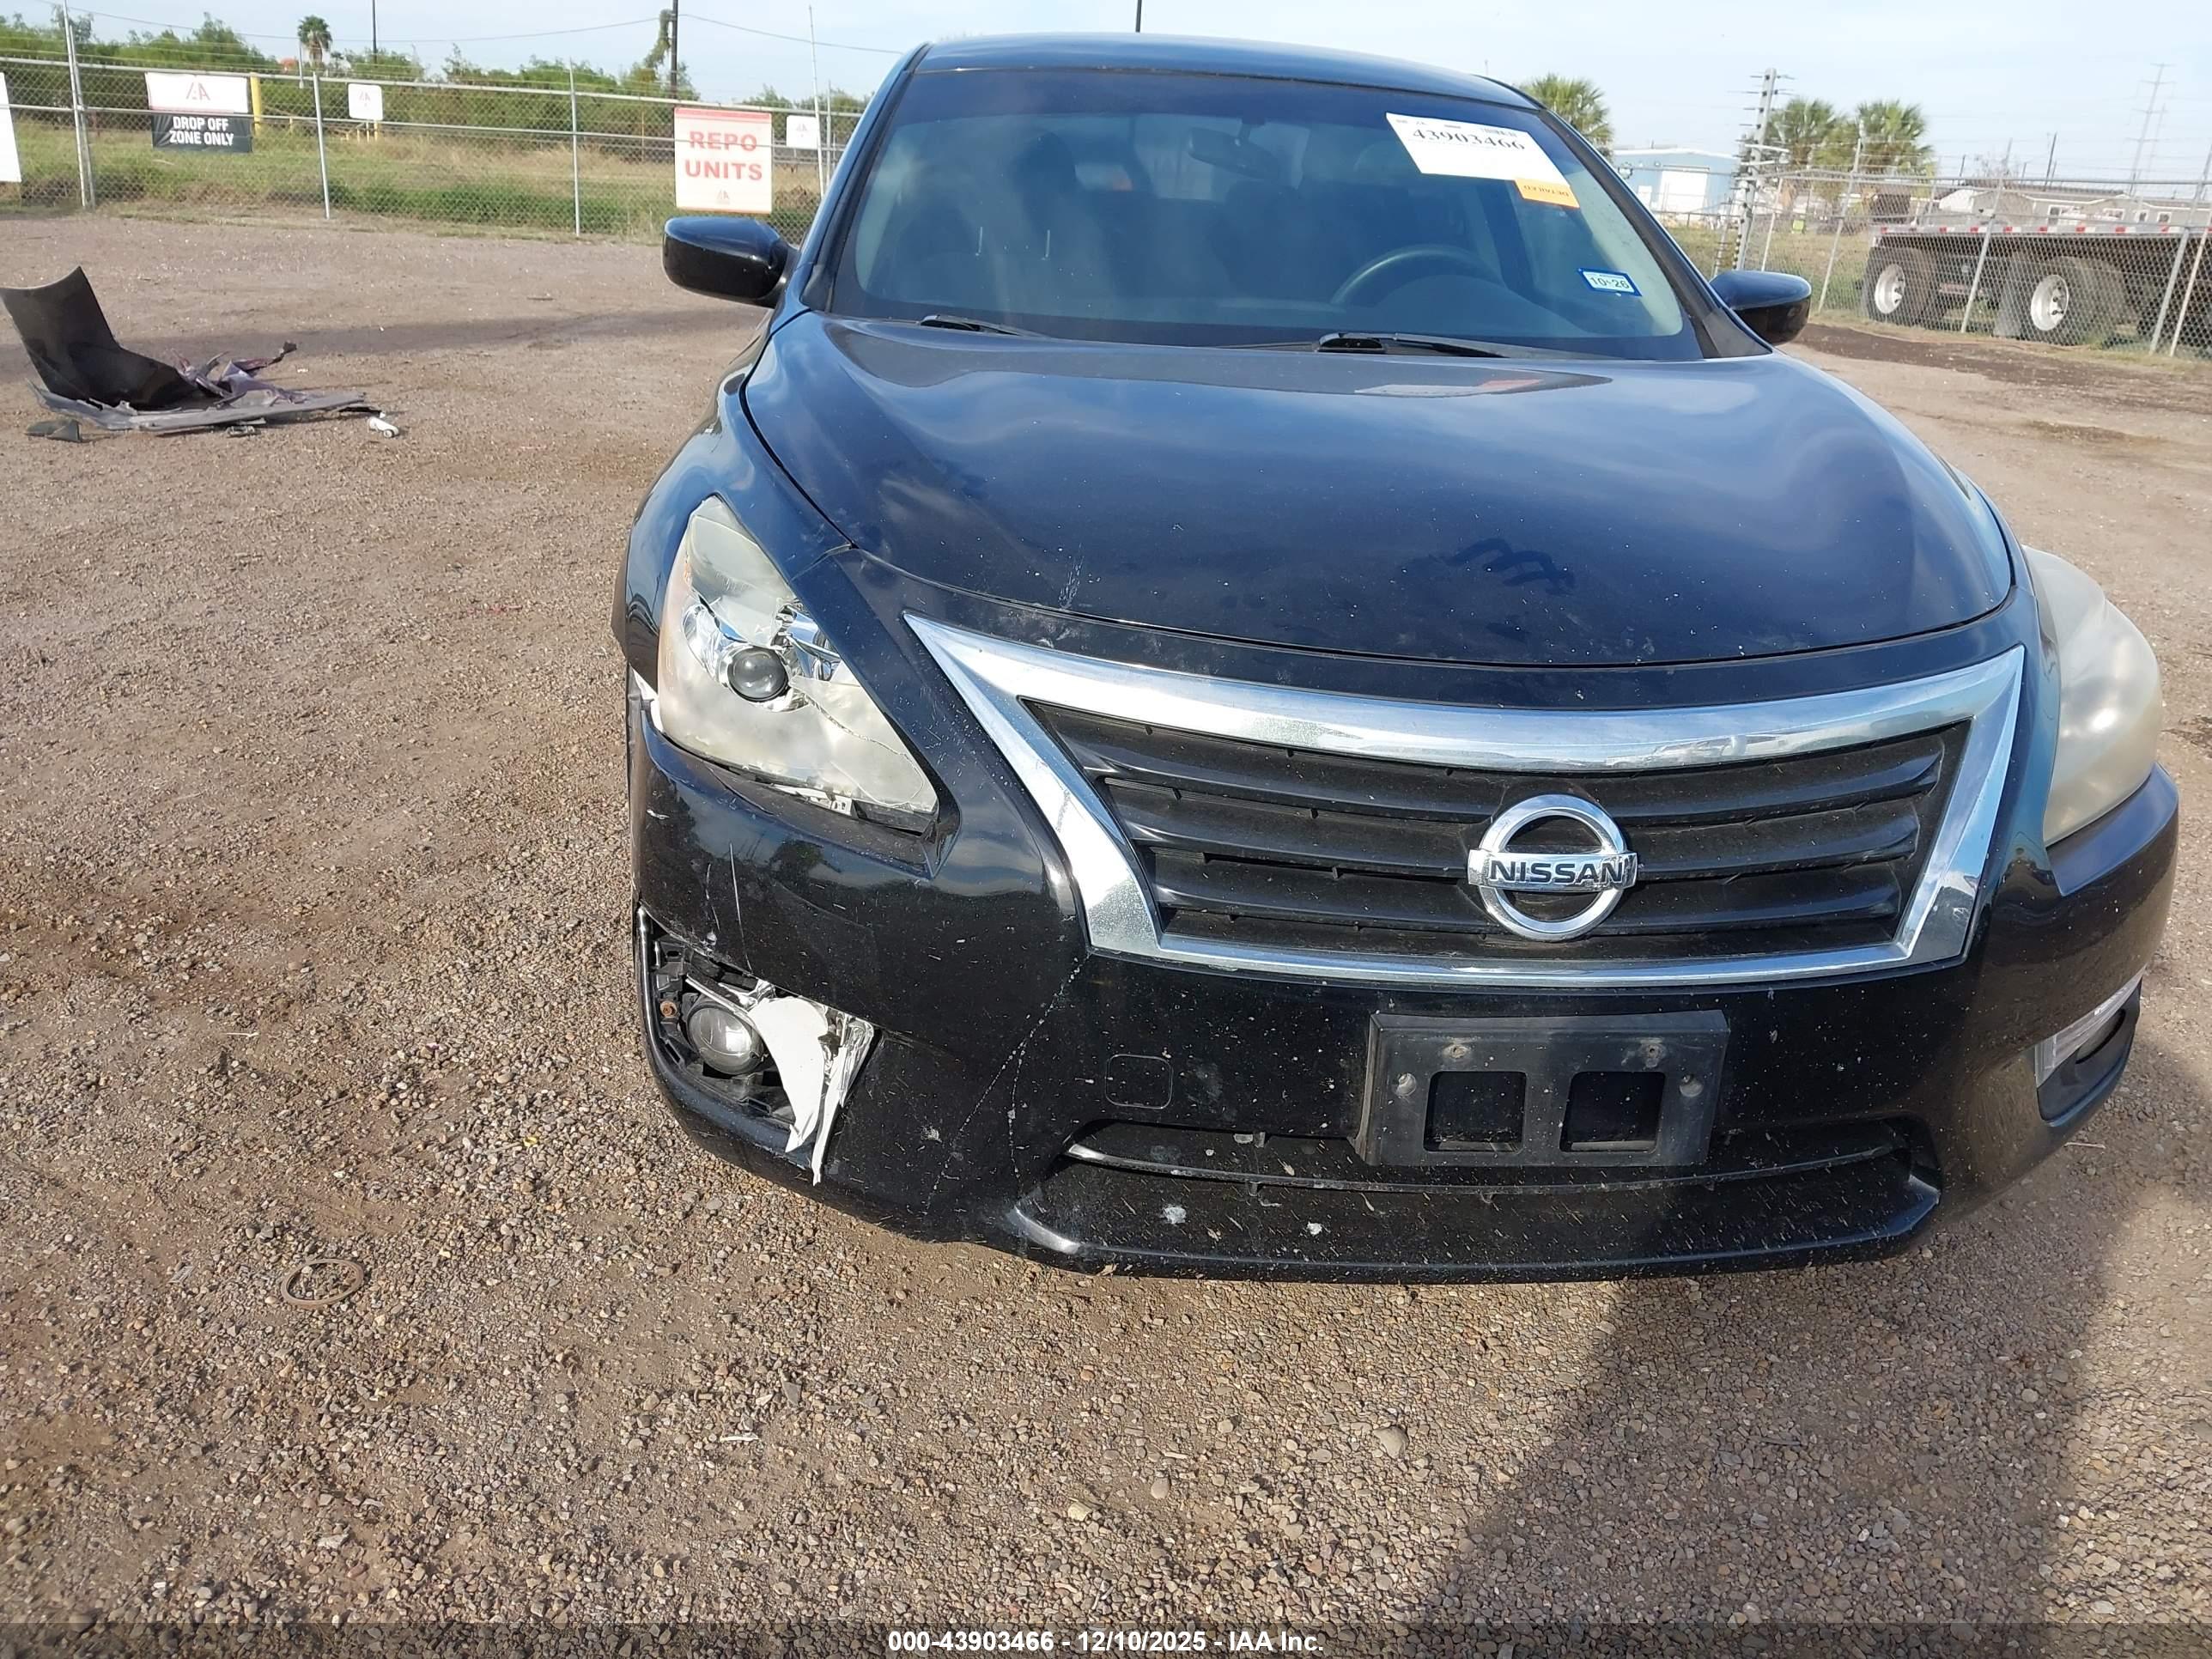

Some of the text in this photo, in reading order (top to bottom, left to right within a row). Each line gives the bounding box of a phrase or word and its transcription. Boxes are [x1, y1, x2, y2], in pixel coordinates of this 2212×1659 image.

[173, 116, 229, 131] DROP OFF
[168, 130, 234, 146] ZONE ONLY
[689, 130, 757, 152] REPO
[1413, 129, 1526, 150] 43903466
[684, 160, 763, 180] UNITS
[1489, 860, 1623, 884] NISSAN
